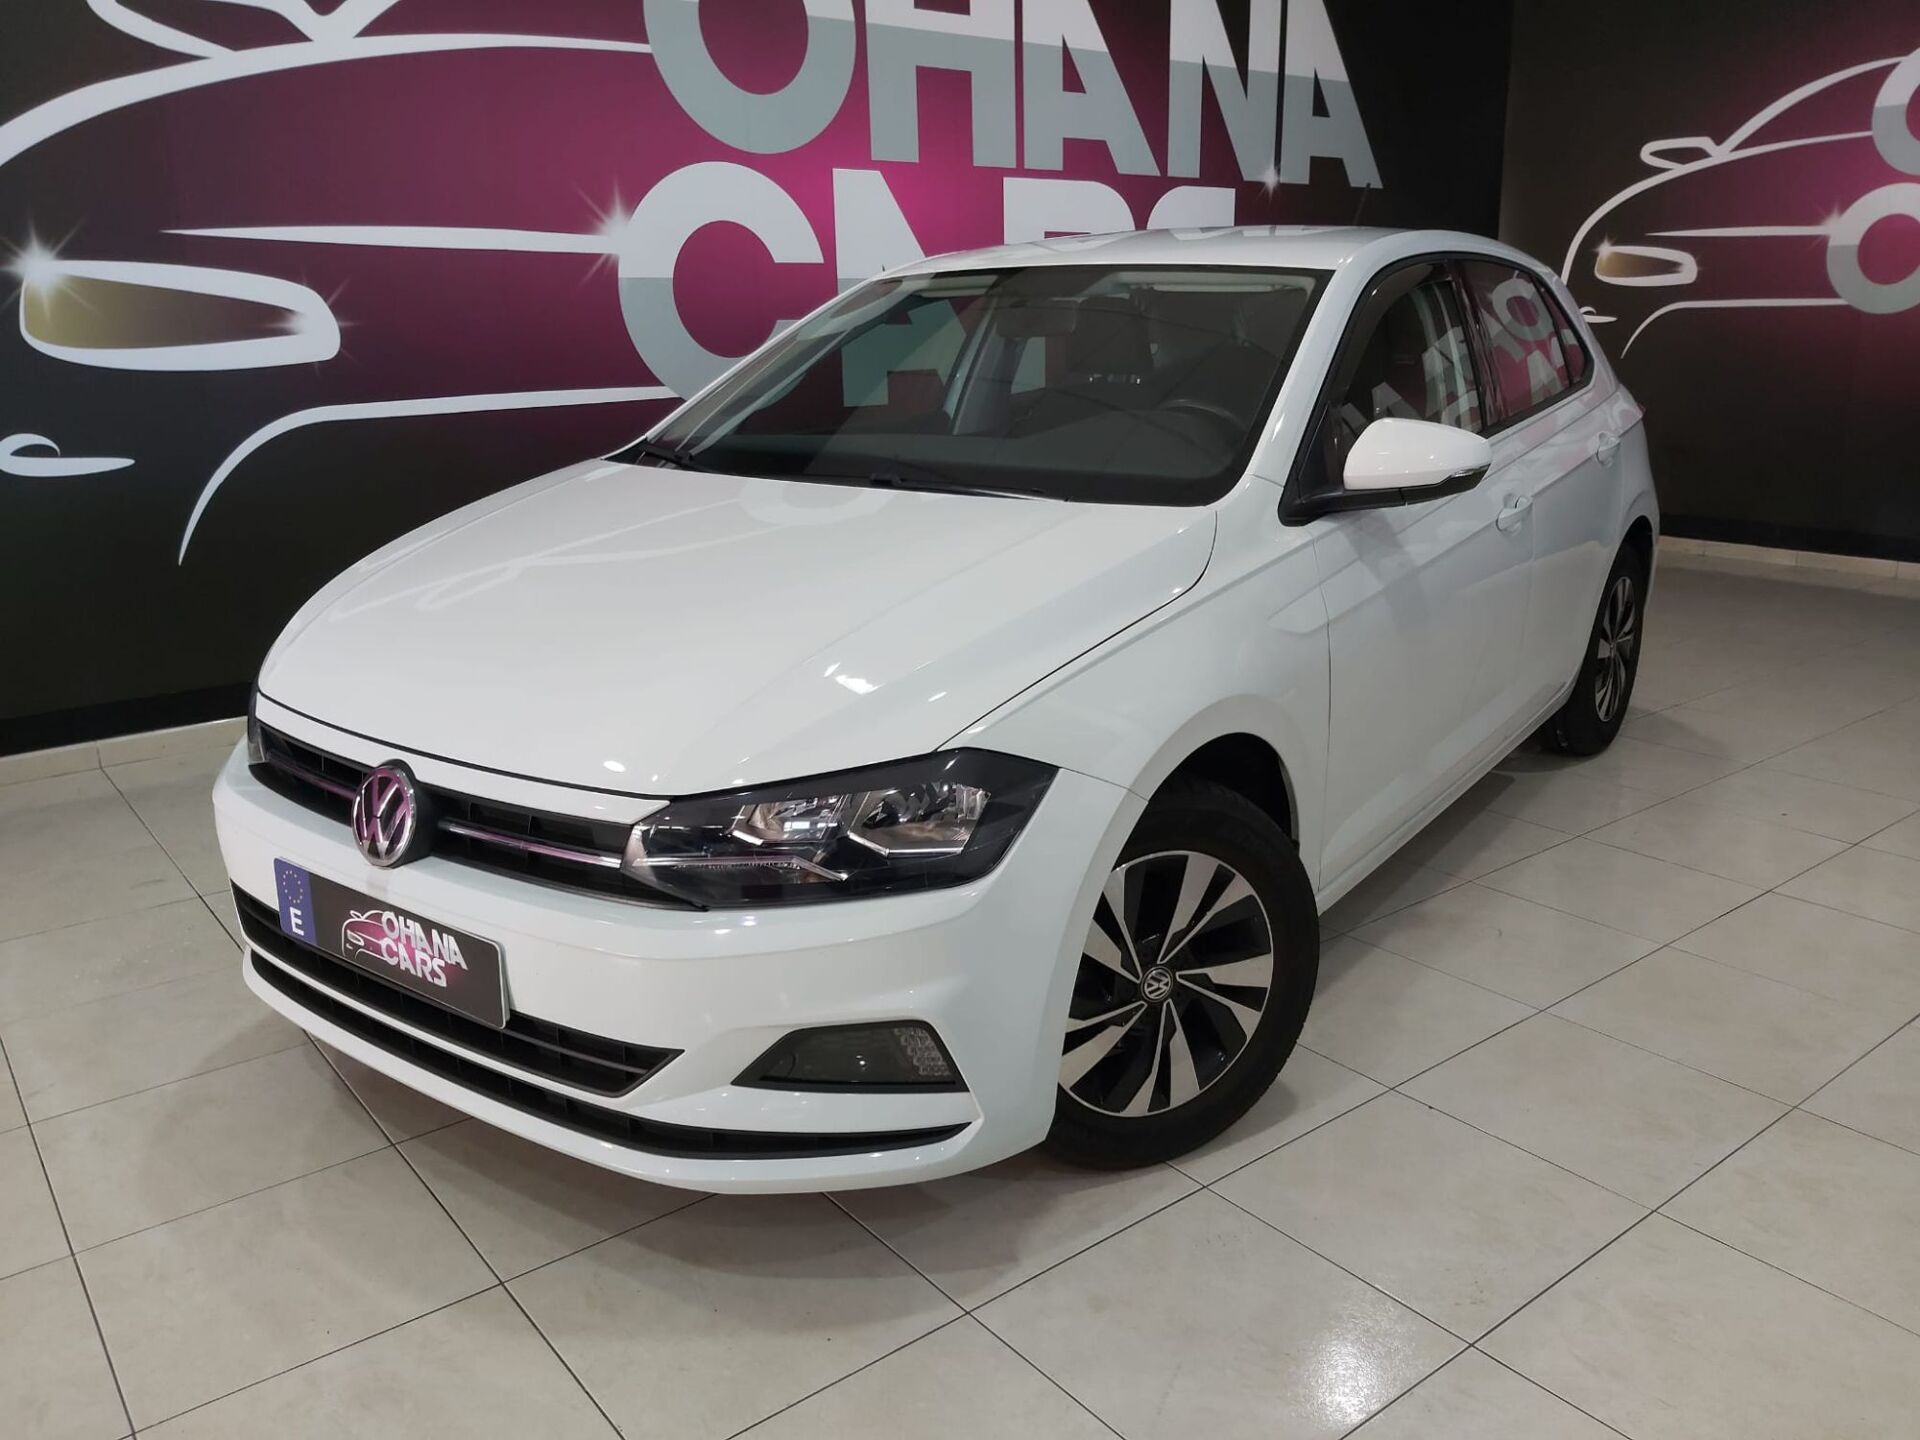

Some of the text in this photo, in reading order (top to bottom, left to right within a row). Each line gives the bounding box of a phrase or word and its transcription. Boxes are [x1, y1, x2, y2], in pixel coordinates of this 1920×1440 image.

[617, 160, 1236, 408] CA
[289, 906, 305, 936] E
[381, 910, 469, 971] OHANA
[380, 936, 448, 988] CARS
